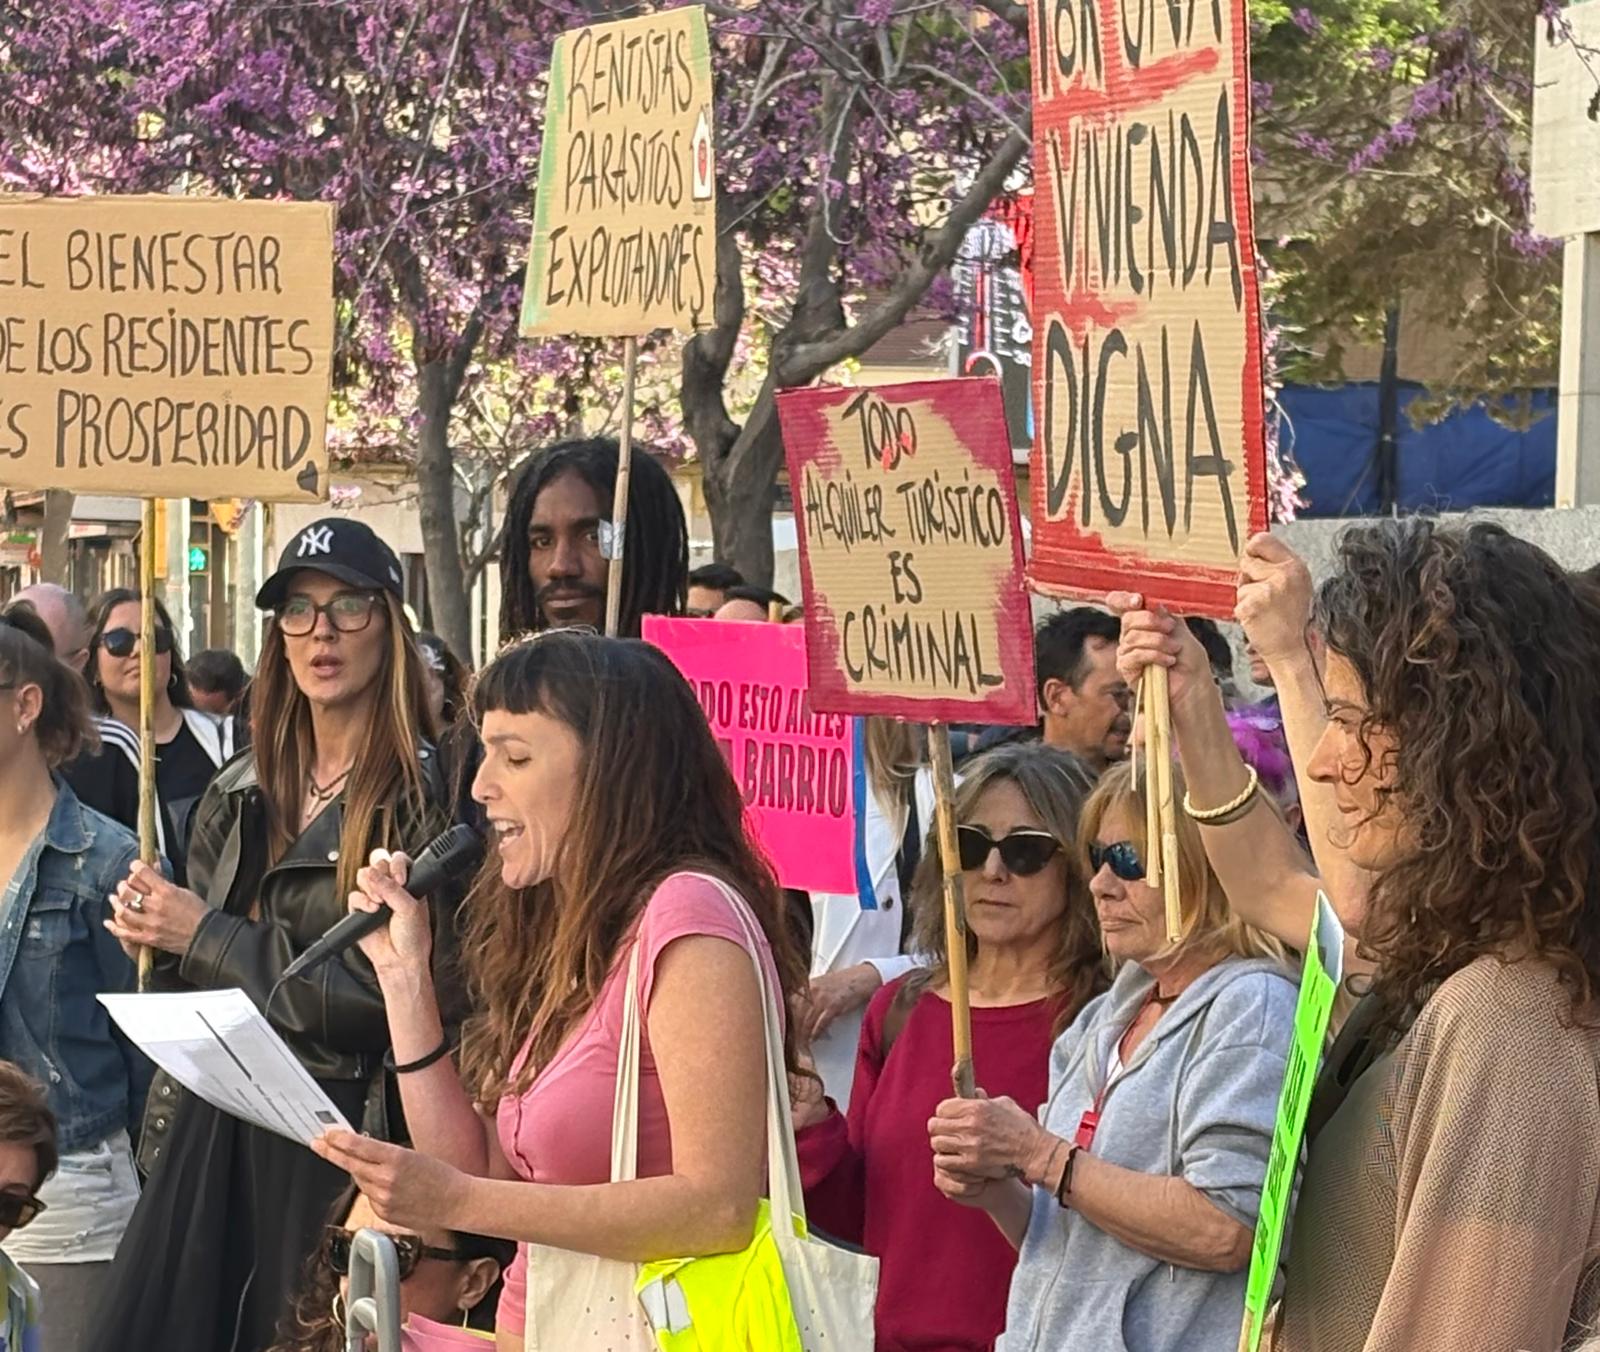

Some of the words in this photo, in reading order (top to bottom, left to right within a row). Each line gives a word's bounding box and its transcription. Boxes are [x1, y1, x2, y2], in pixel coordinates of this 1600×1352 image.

[567, 28, 693, 133] RENTISTAS
[565, 126, 683, 215] PARASITOS
[1050, 82, 1242, 313] VIVIENDA
[0, 229, 45, 288] EL
[67, 229, 283, 295] BIENESTAR
[546, 223, 705, 318] EXPLOTADORES
[37, 319, 94, 375] LOS
[103, 308, 313, 378] RESIDENTES
[0, 402, 32, 459] S
[55, 388, 311, 471] PROSPERIDAD
[842, 389, 917, 470] TODO
[1045, 319, 1239, 558] DIGNA
[296, 525, 335, 557] NY
[888, 551, 923, 604] ES
[843, 604, 1004, 694] CRIMINAL
[689, 678, 732, 728] DO
[738, 684, 782, 733] ESTO
[743, 738, 848, 818] BARRIO
